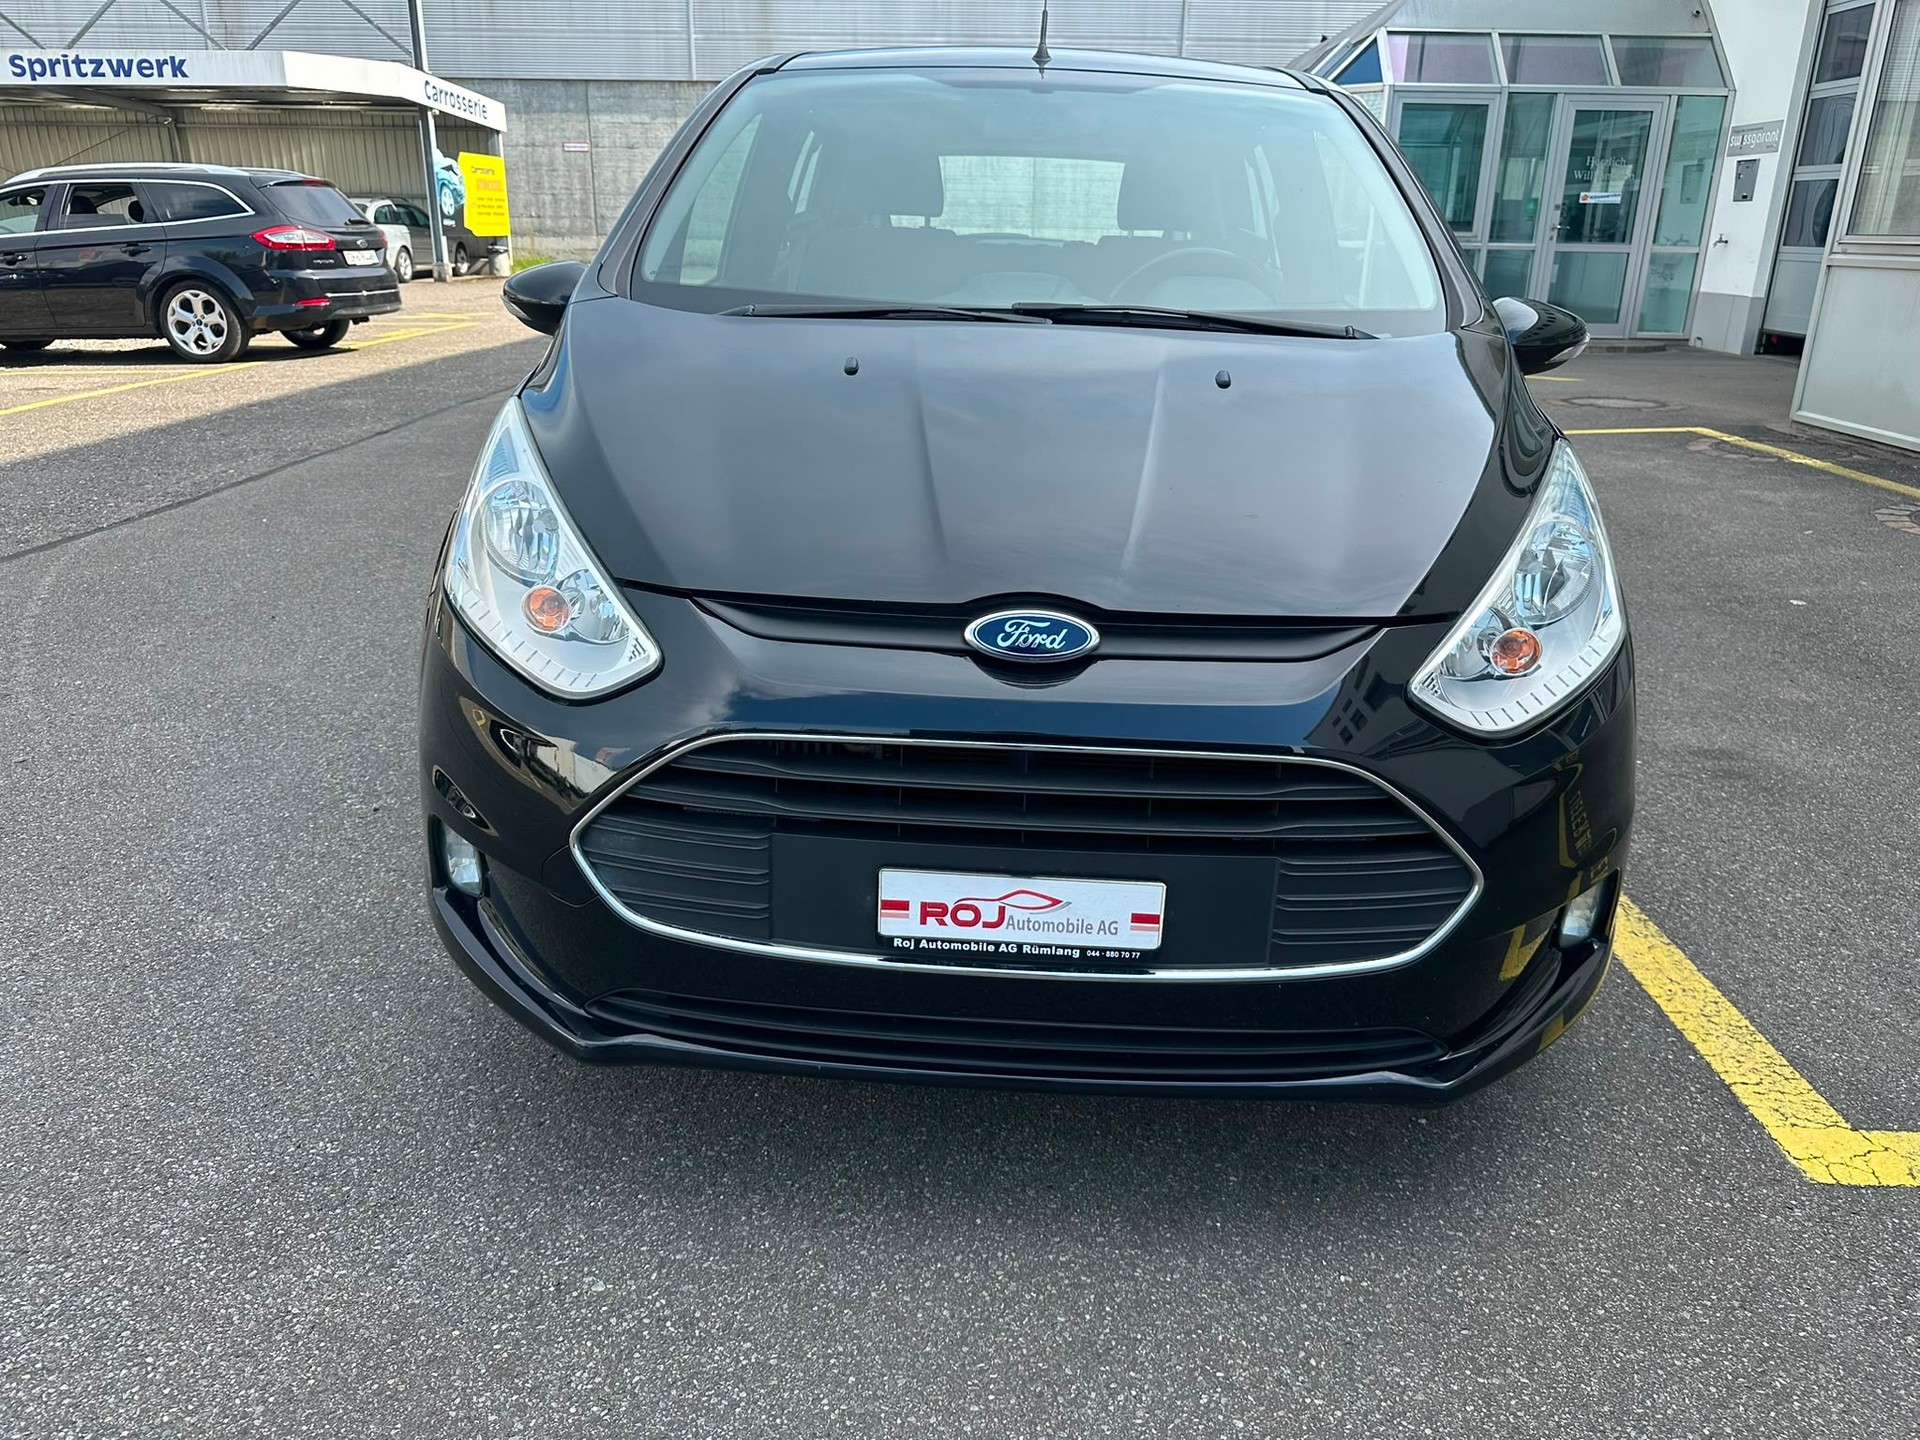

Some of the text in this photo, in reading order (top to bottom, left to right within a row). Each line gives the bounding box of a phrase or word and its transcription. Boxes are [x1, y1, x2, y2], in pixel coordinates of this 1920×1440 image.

[8, 54, 189, 81] Spritzwerk
[424, 79, 488, 120] Carrosserie
[1730, 128, 1780, 149] swissgarant
[1586, 155, 1626, 169] Herzlich
[997, 619, 1068, 649] Ford
[919, 901, 1119, 936] ROJ Automobile AG
[893, 937, 915, 950] Roj
[919, 939, 995, 952] Automobile
[998, 942, 1018, 954] AG
[1022, 944, 1080, 958] Rümlang
[1105, 950, 1120, 958] 880
[1120, 951, 1131, 959] 70
[1131, 951, 1141, 959] 77
